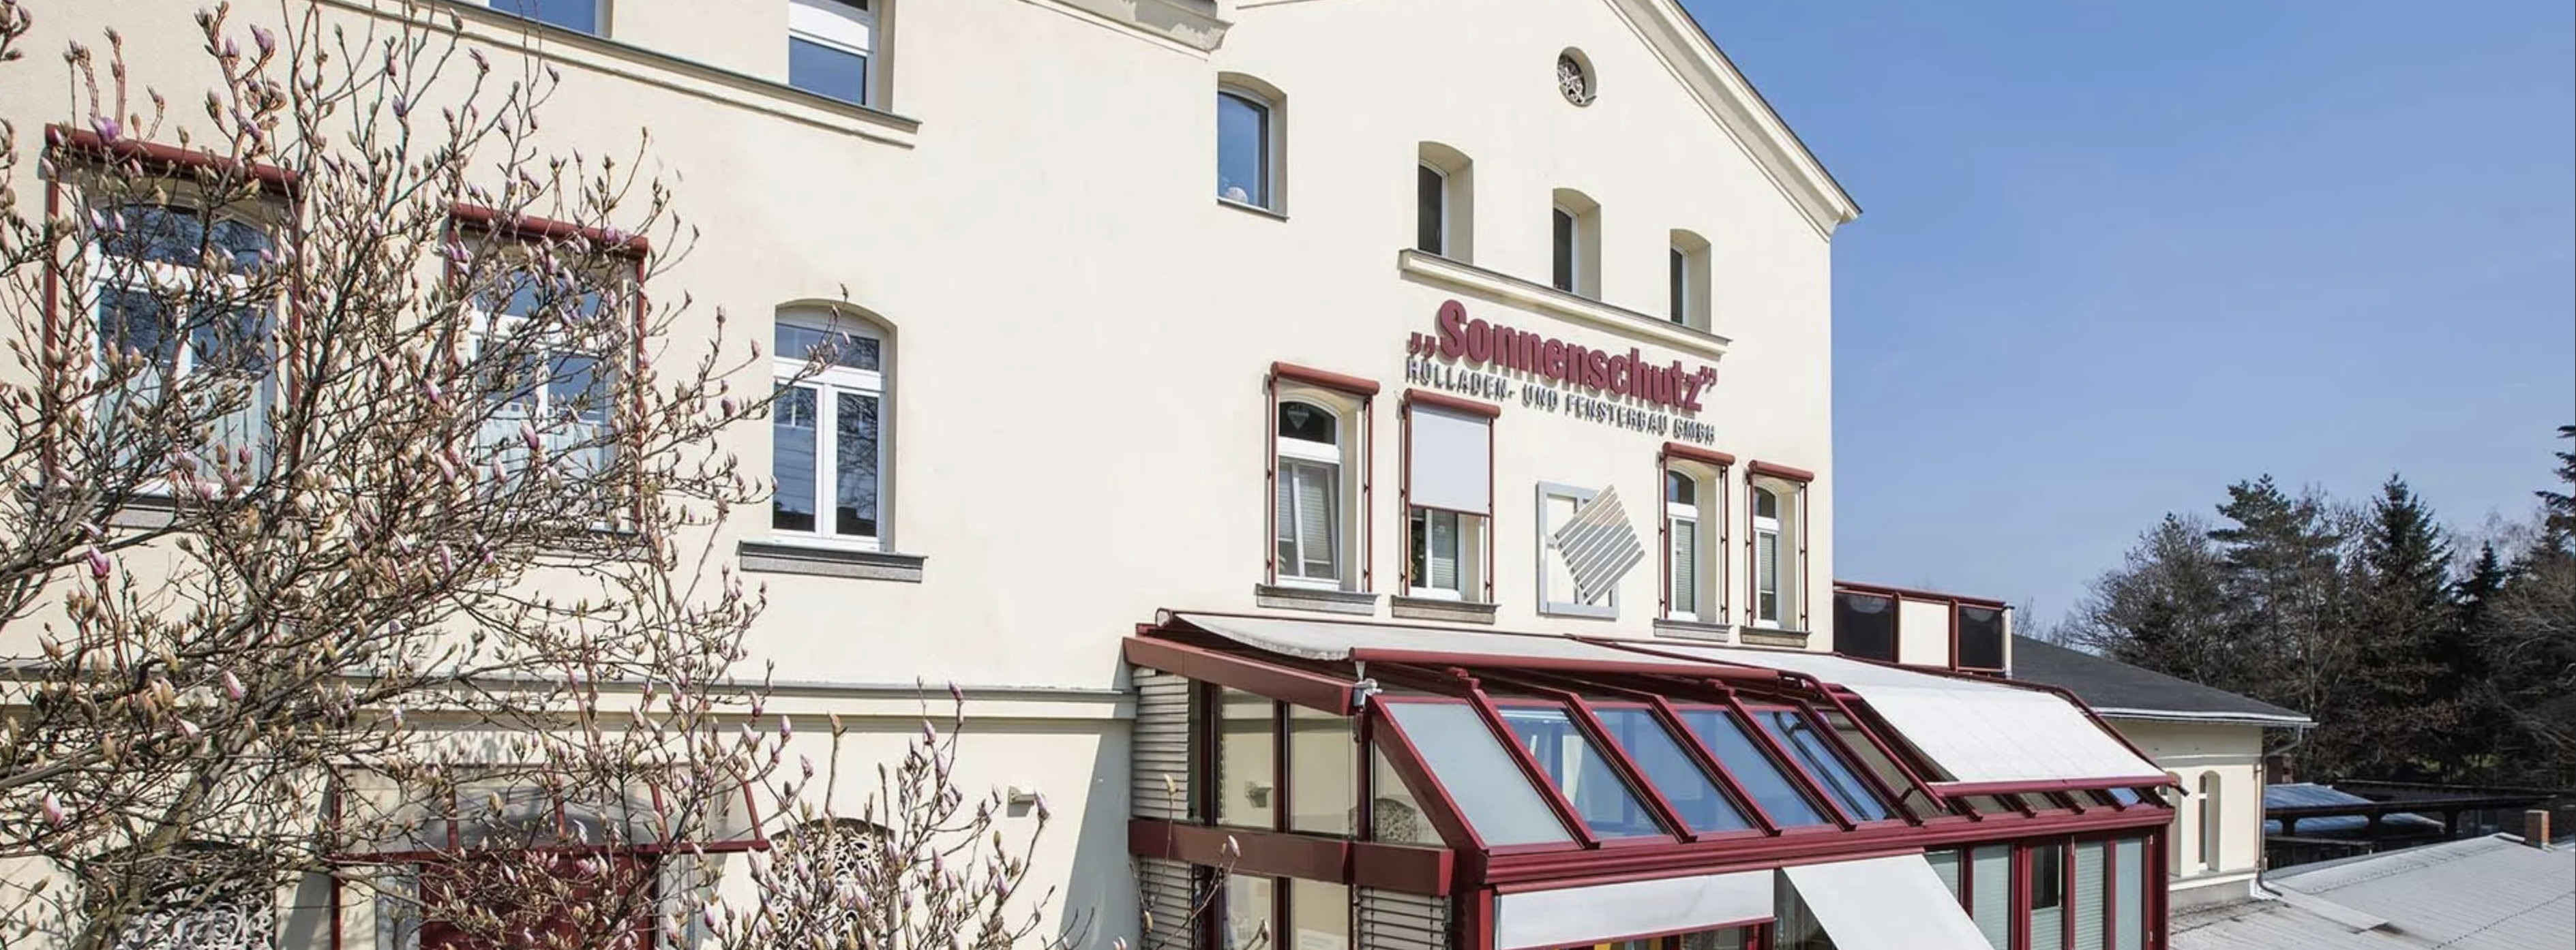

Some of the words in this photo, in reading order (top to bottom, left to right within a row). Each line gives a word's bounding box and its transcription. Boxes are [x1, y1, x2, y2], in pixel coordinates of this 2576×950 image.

[1407, 356, 1515, 401] ROLLADEN-
[1522, 384, 1558, 412] UND
[1565, 393, 1668, 436] FENSTERBAU
[1673, 417, 1715, 446] GMBH
